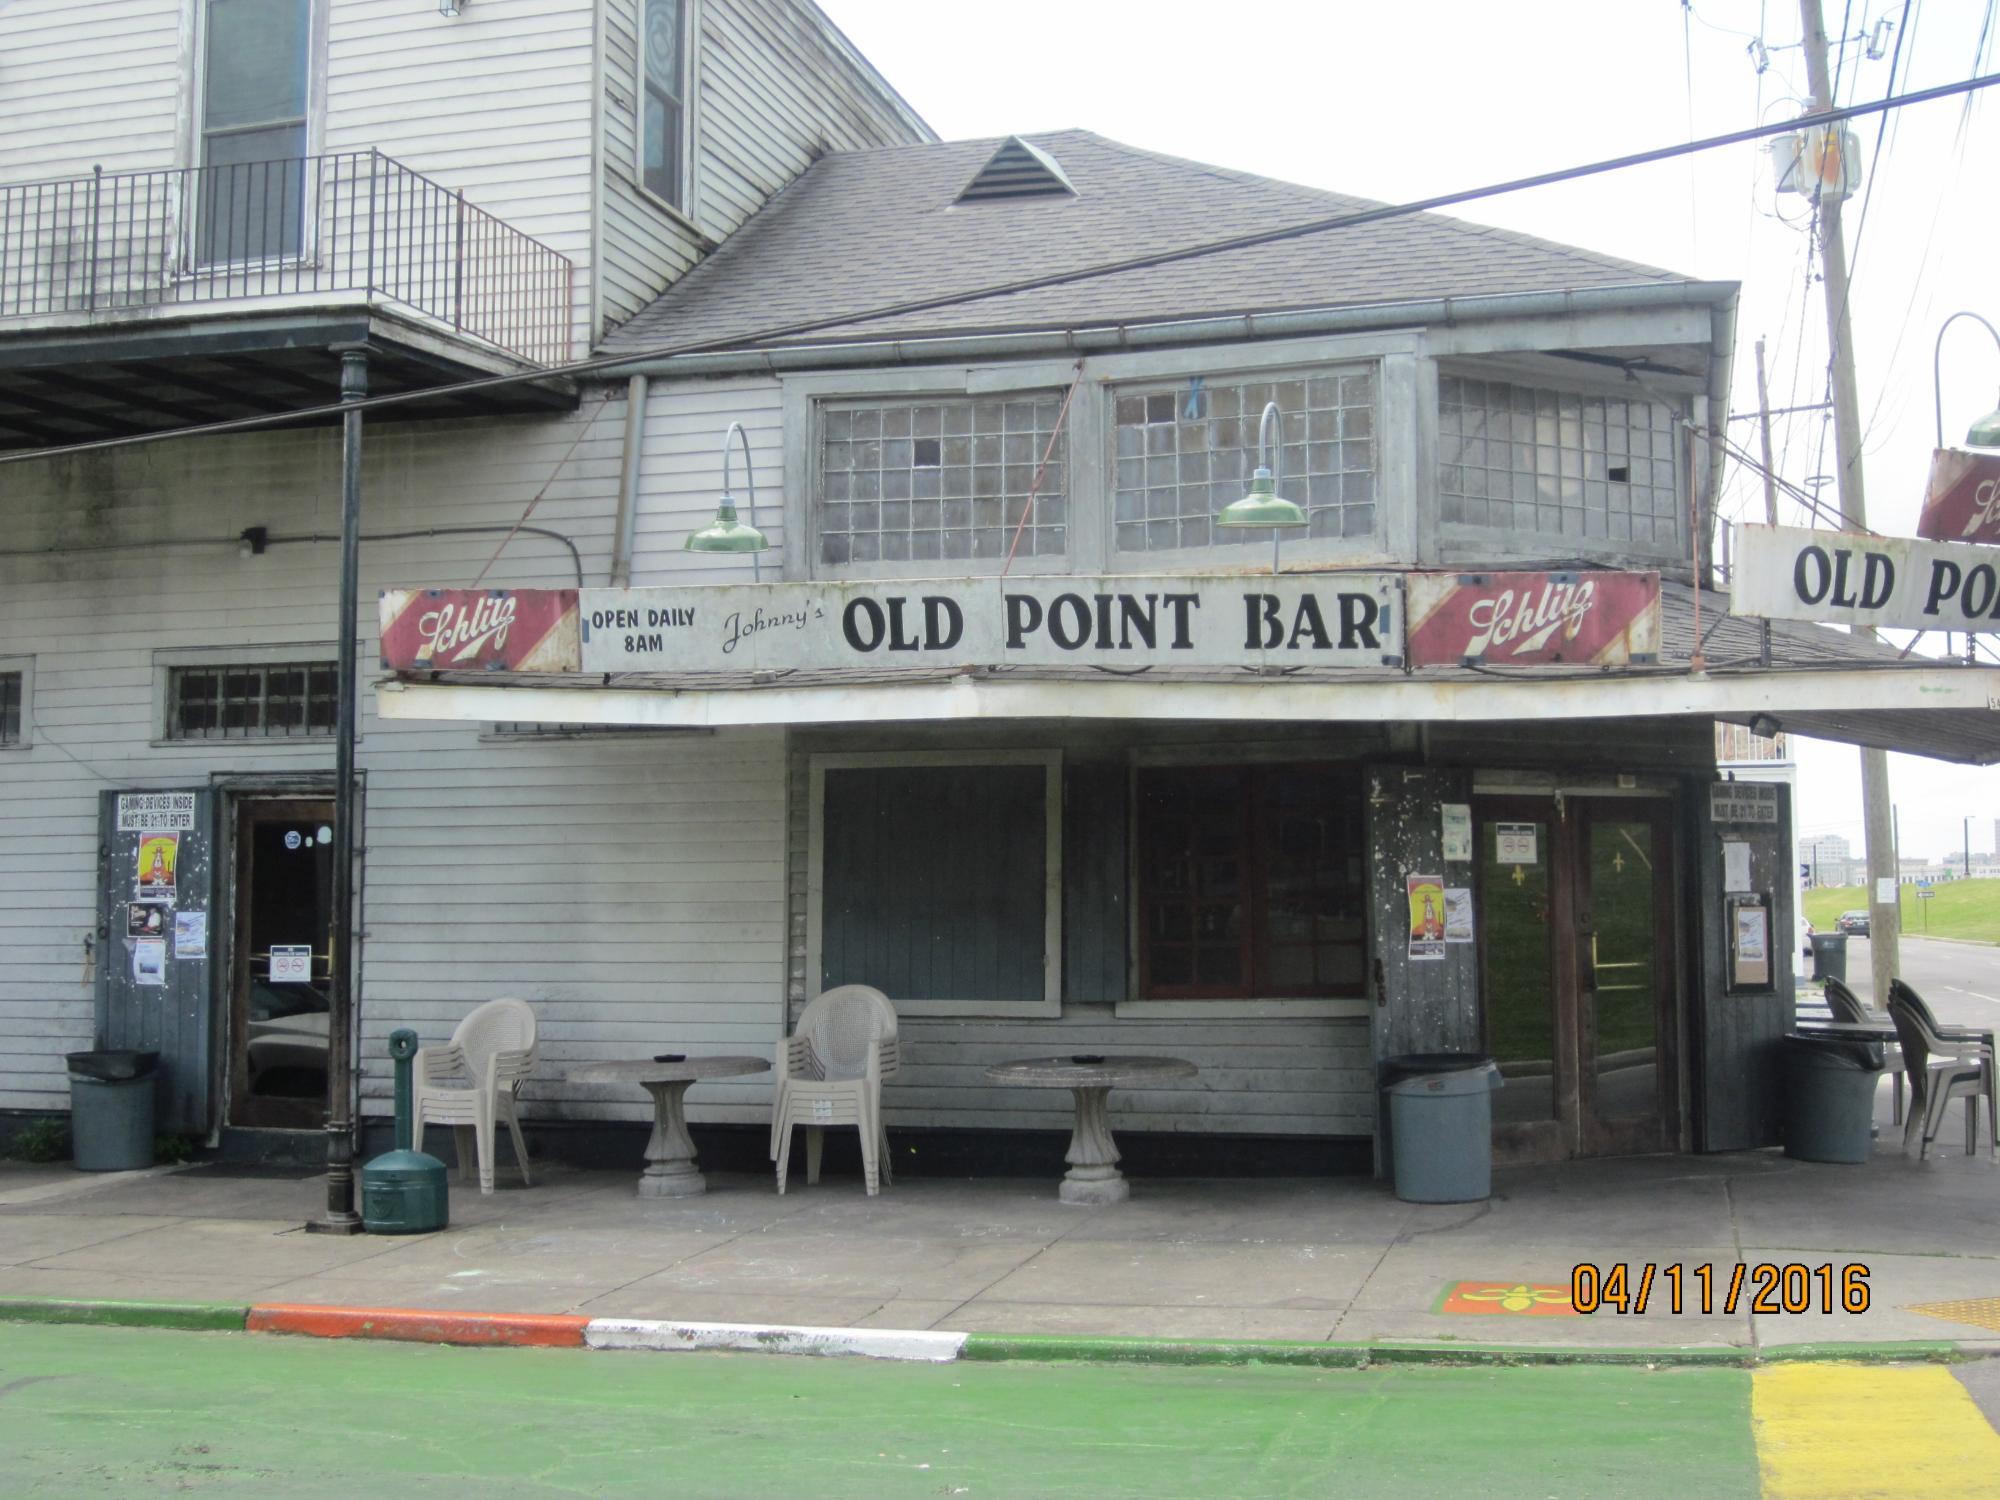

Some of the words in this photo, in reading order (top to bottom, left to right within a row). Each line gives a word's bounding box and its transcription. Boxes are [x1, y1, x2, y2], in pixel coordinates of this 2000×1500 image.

[1793, 545, 1896, 610] OLD
[415, 596, 517, 662] Schlitz
[592, 608, 639, 629] OPEN
[647, 607, 696, 628] DAILY
[722, 599, 825, 654] Johnny's
[841, 595, 965, 653] OLD
[1003, 592, 1201, 651] POINT
[1242, 592, 1382, 650] BAR
[1463, 580, 1595, 656] Schlitz
[624, 633, 664, 653] 8AM
[121, 814, 139, 828] MUST
[140, 813, 148, 828] BE
[159, 813, 168, 828] TO
[170, 813, 191, 828] ENTER
[145, 795, 170, 810] DEVICES
[172, 795, 193, 810] INSIDE
